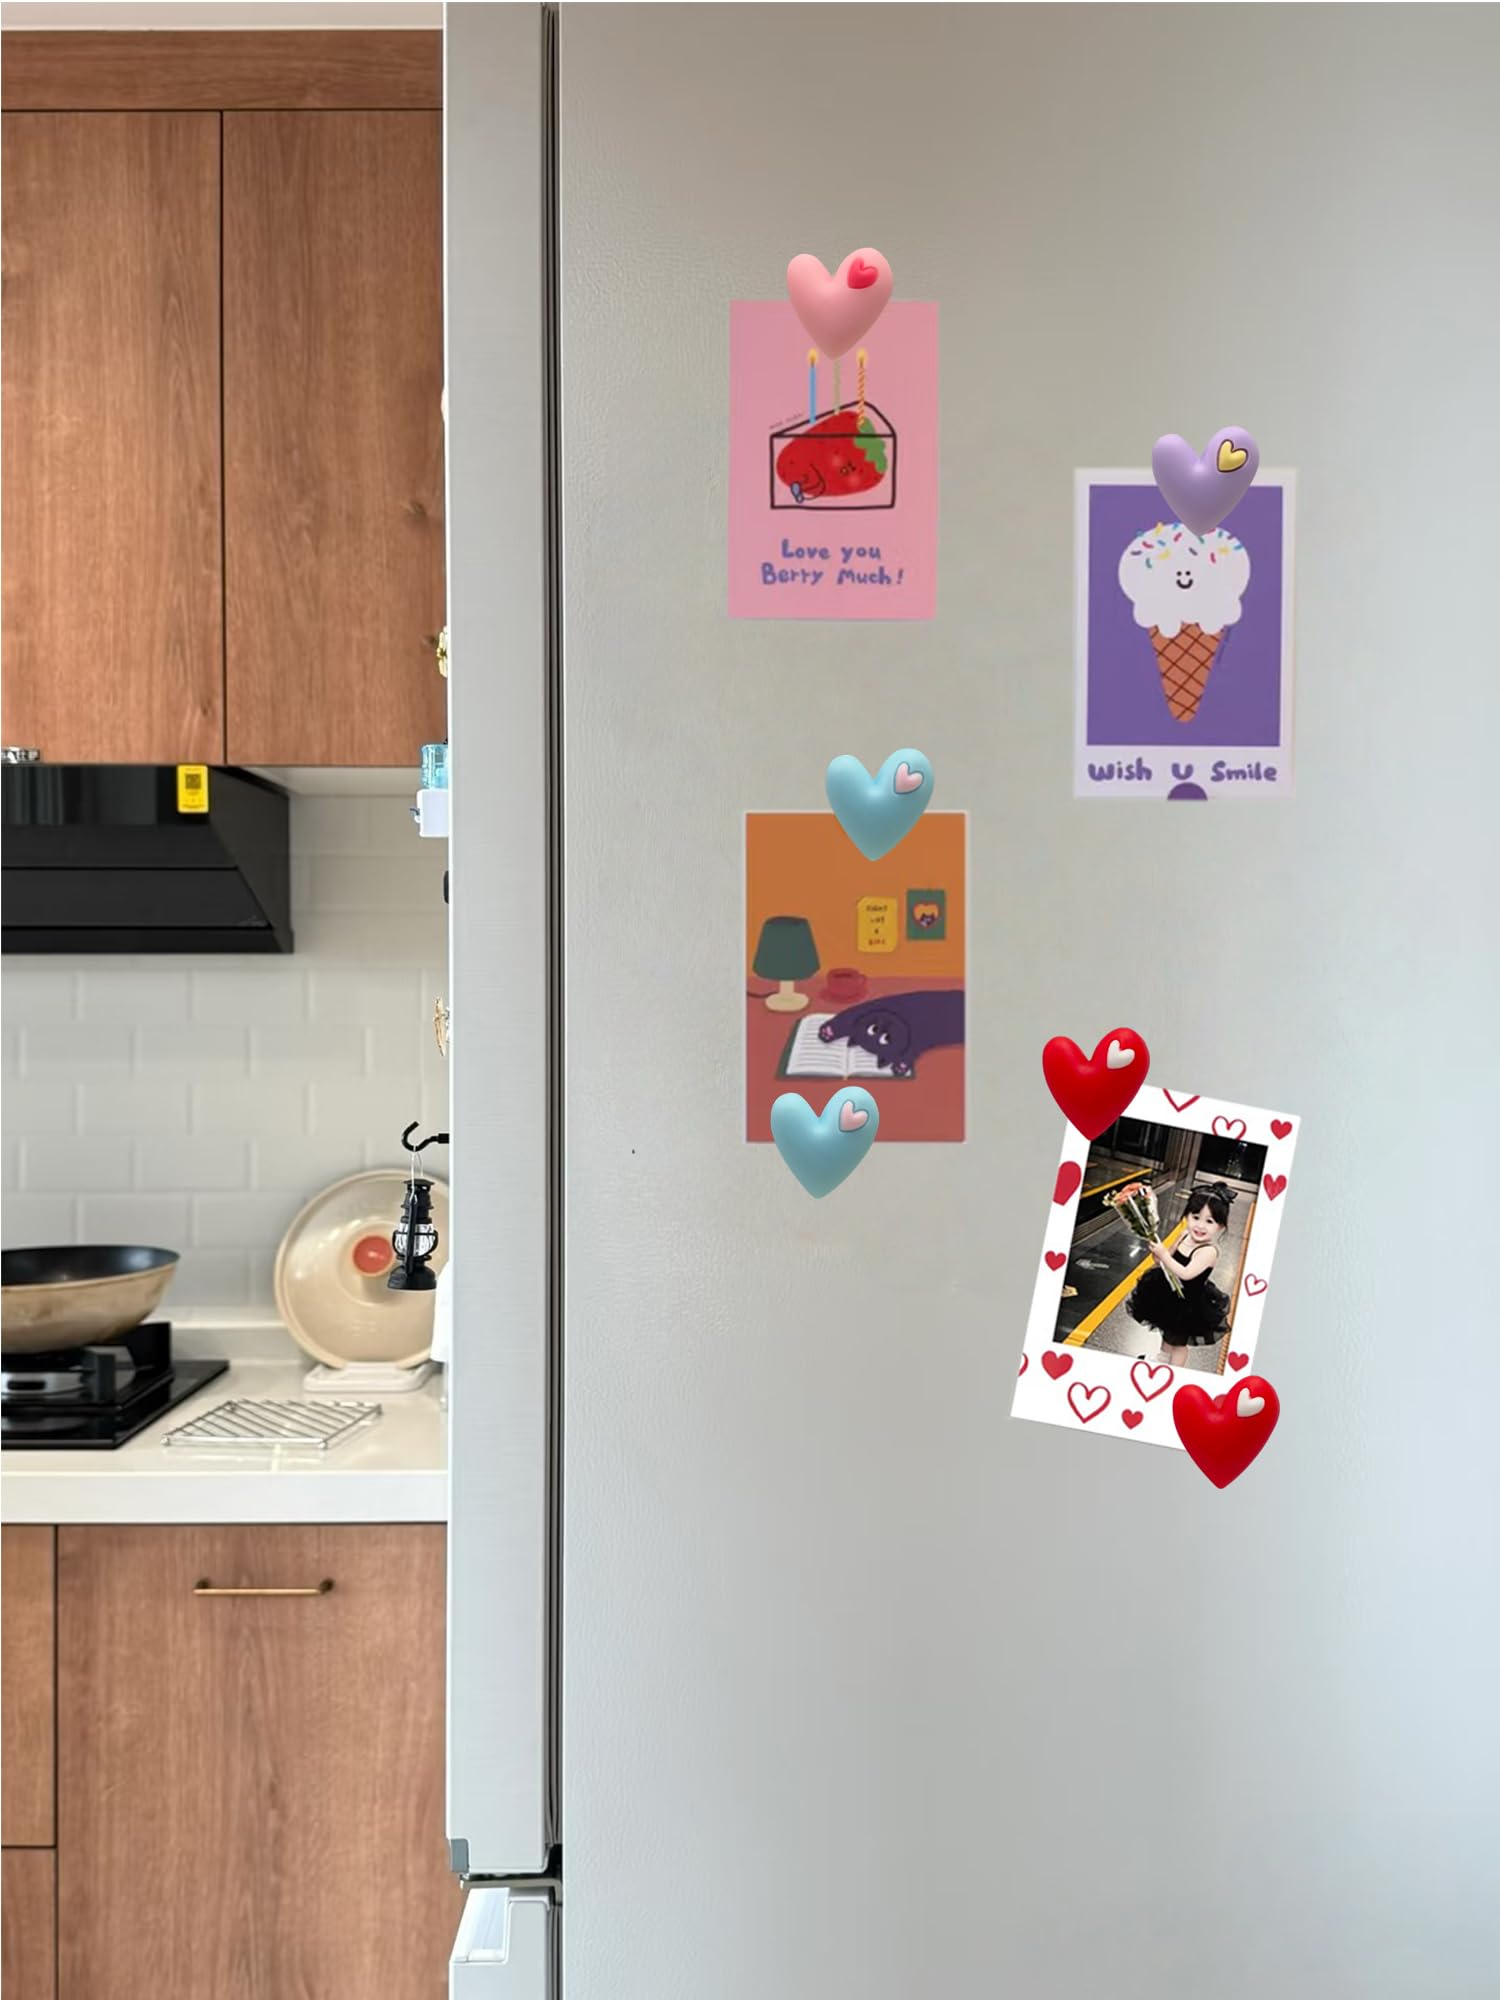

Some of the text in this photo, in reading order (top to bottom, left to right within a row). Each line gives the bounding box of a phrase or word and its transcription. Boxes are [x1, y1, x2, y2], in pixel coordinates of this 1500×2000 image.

[781, 538, 882, 564] Love you
[761, 561, 824, 586] Berry
[1209, 760, 1278, 783] Smile
